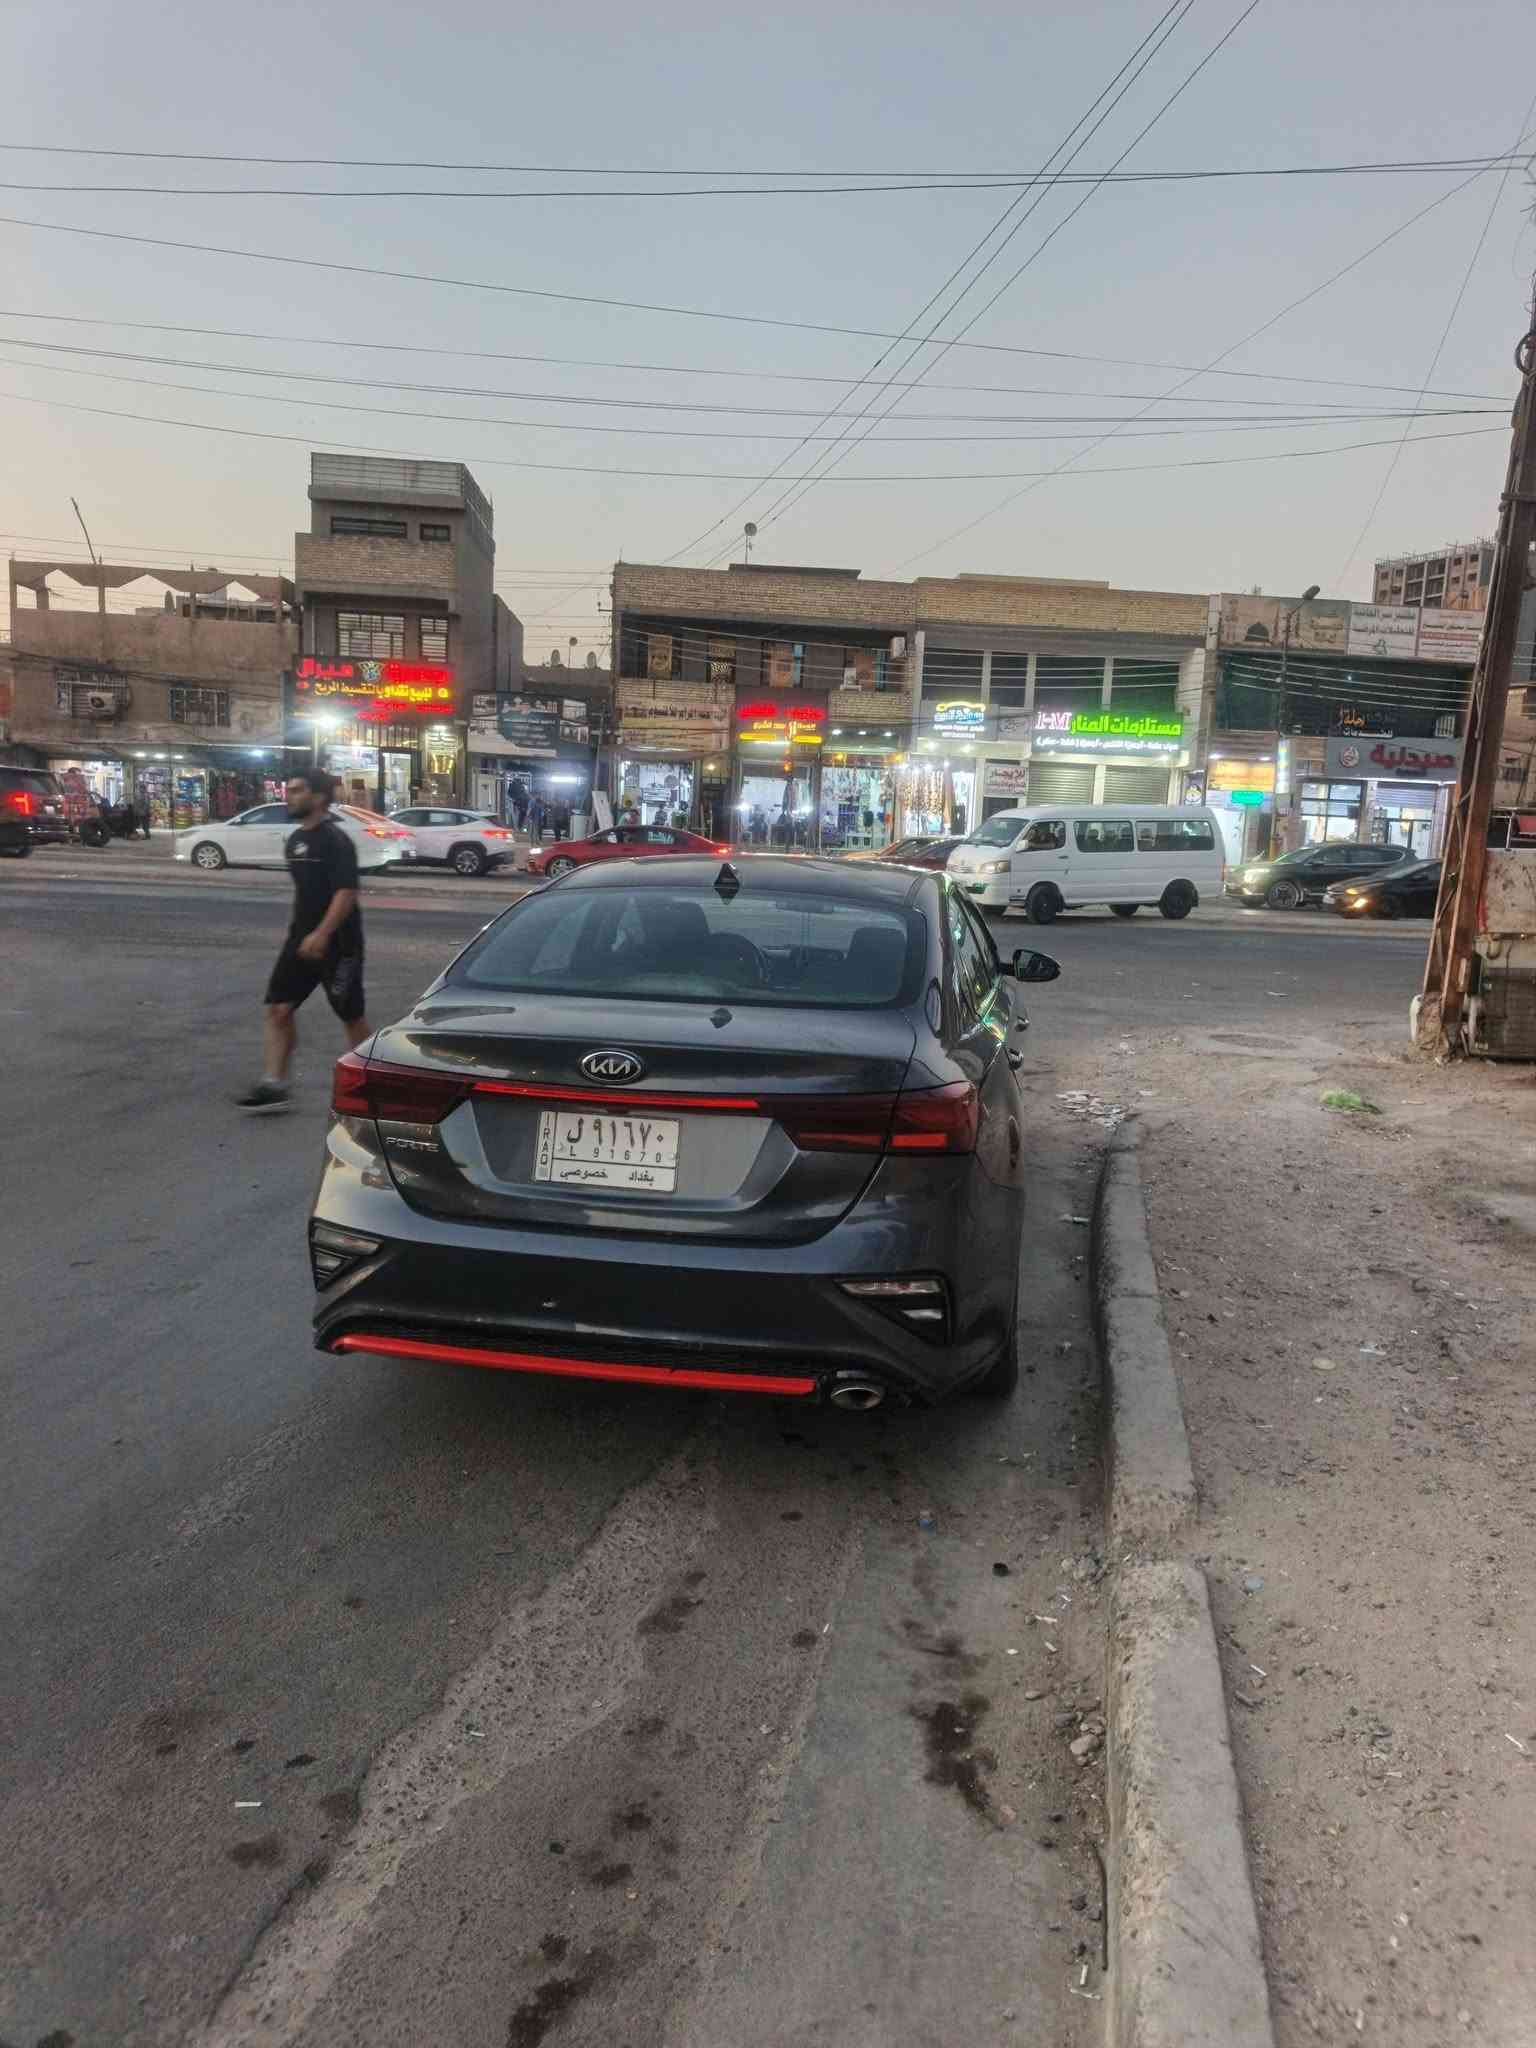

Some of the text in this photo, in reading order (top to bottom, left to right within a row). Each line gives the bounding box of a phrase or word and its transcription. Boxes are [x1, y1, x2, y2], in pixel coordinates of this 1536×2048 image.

[1070, 714, 1181, 737] مستلزمات المنار
[1369, 743, 1456, 769] صيدلية
[590, 1058, 631, 1075] KIA
[540, 1112, 551, 1166] IRAQ
[559, 1168, 655, 1187] بغداد خصوصي
